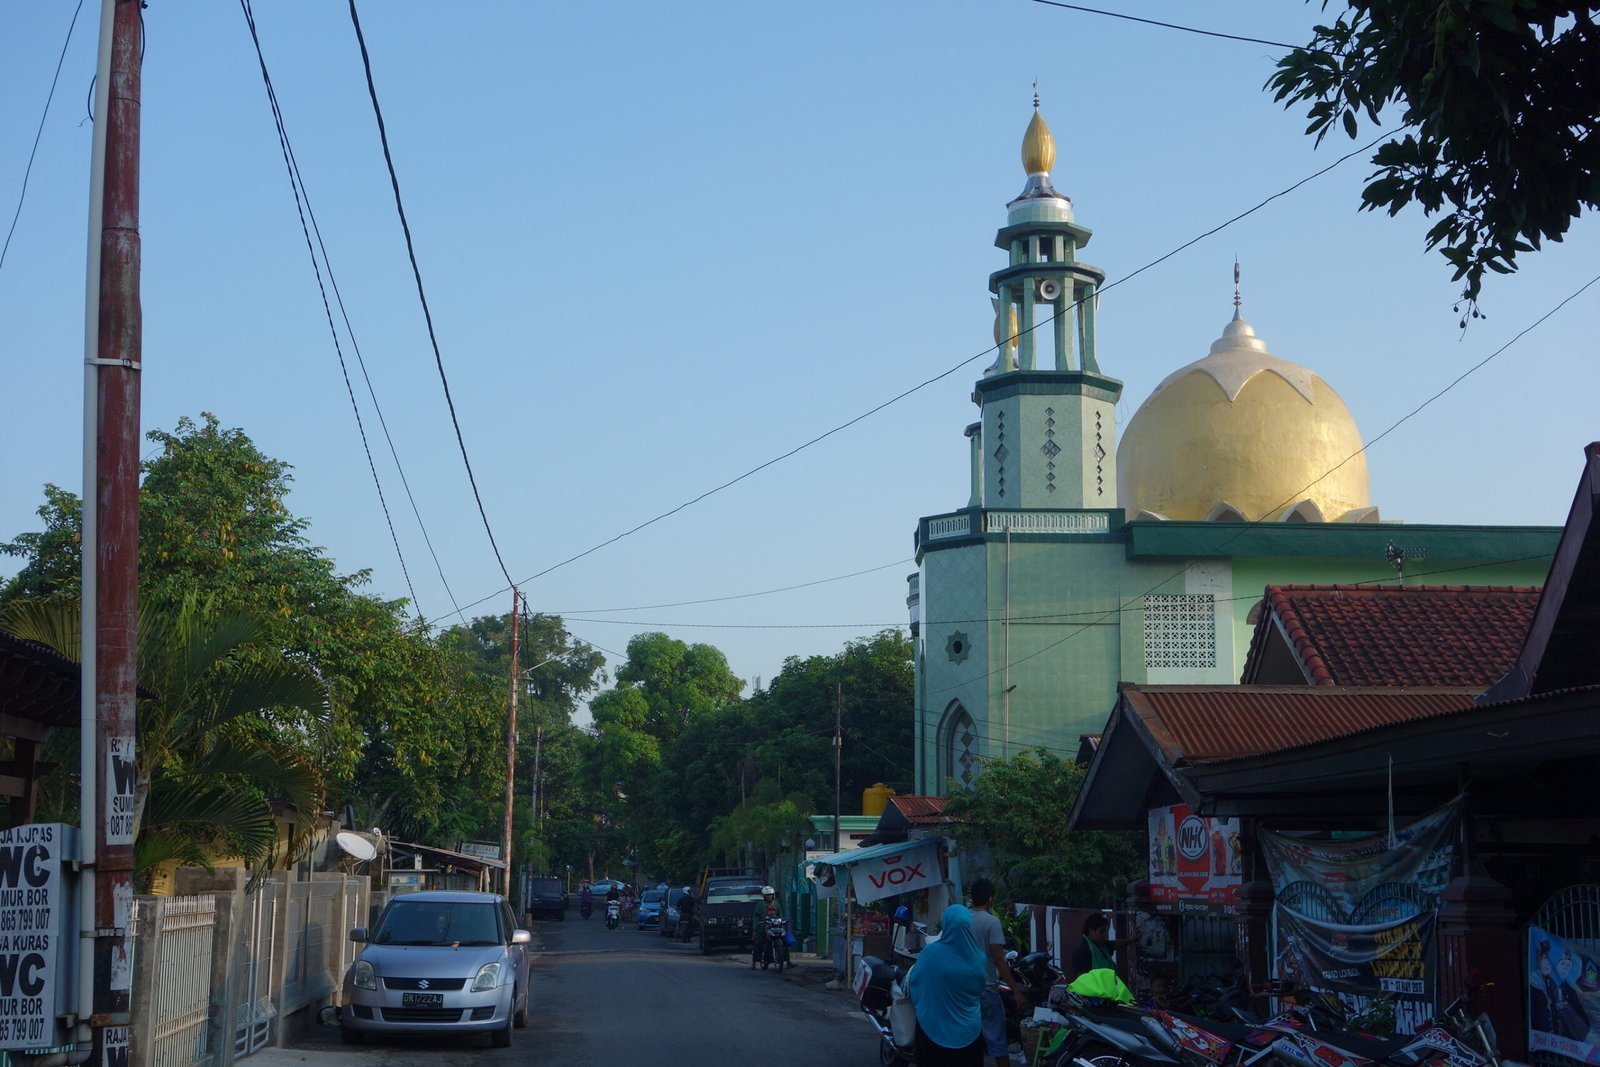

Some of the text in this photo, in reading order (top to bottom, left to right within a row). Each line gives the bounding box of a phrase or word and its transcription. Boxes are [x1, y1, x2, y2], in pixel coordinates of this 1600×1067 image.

[110, 815, 124, 836] 087
[1180, 826, 1205, 848] NHK
[868, 862, 926, 889] VOX
[26, 888, 49, 906] BOR
[18, 909, 33, 930] 799
[35, 908, 51, 930] 007
[12, 934, 49, 951] KURAS
[20, 998, 43, 1015] BOR
[11, 1019, 27, 1041] 799
[28, 1018, 45, 1040] 007
